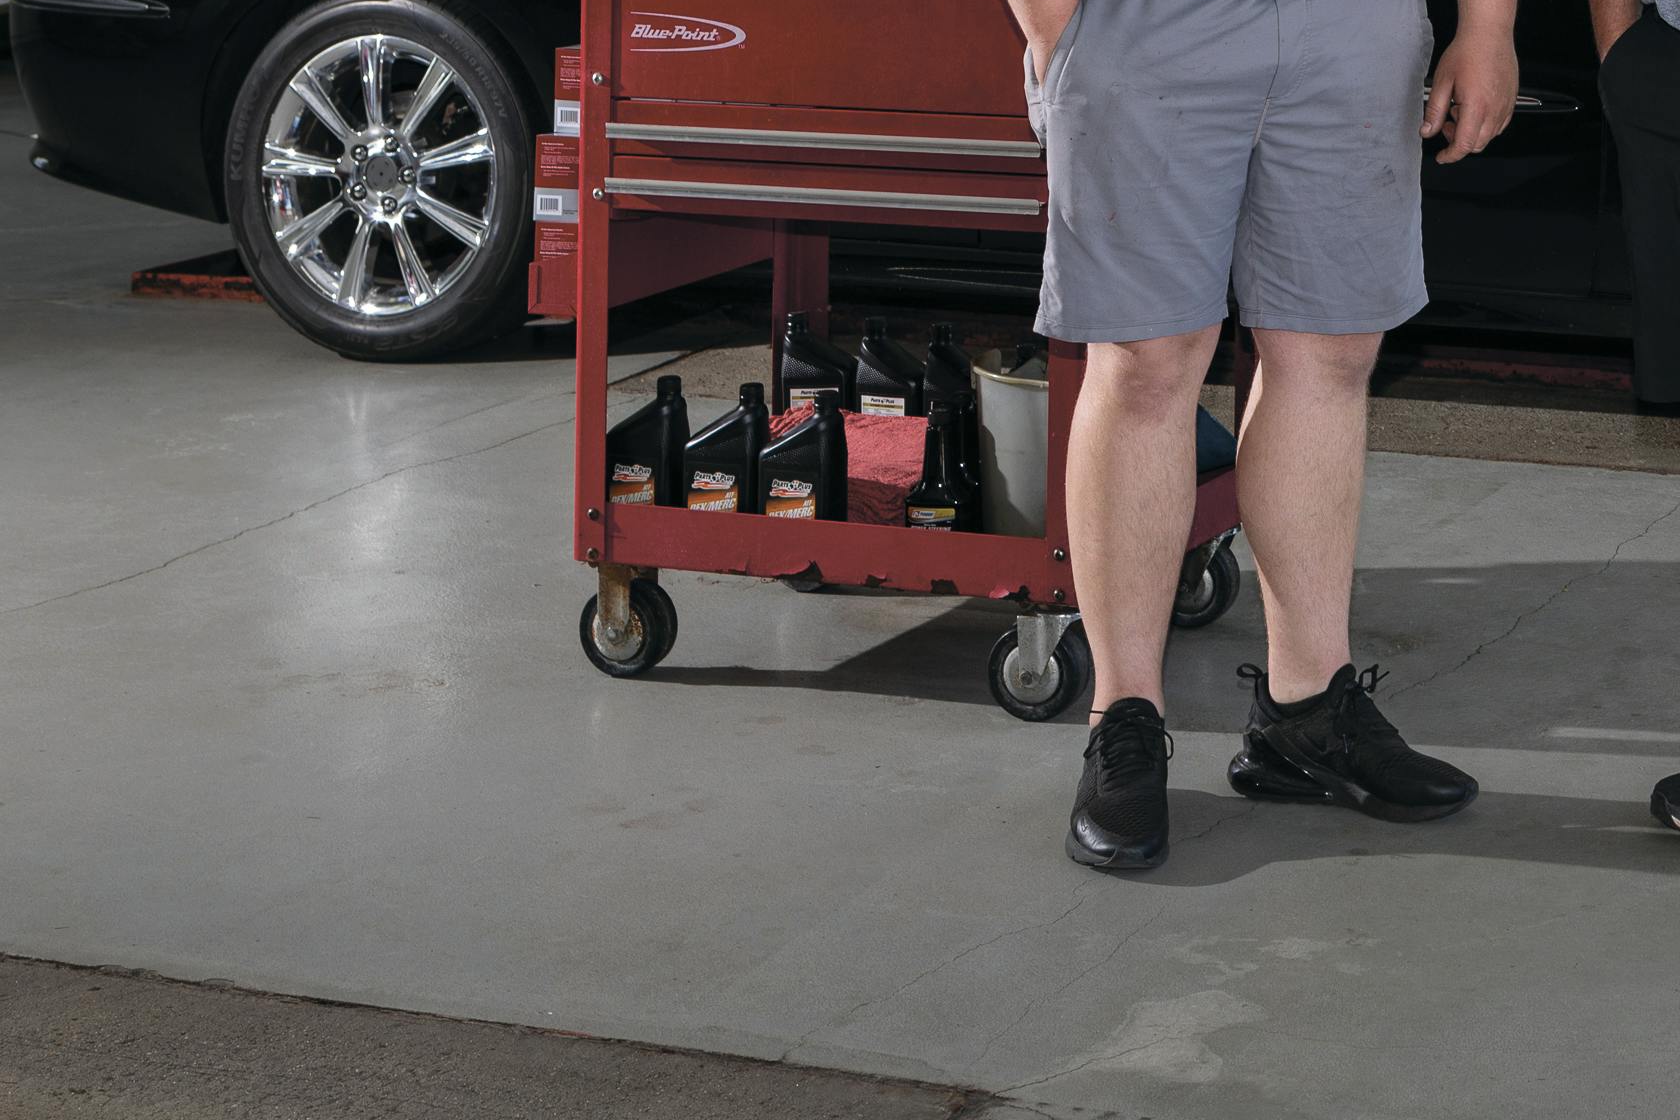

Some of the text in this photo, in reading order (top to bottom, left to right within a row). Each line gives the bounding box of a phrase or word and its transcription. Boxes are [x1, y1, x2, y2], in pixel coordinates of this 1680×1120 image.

[638, 466, 652, 475] PLUS
[720, 473, 735, 482] PLUS
[797, 481, 812, 491] PLUS
